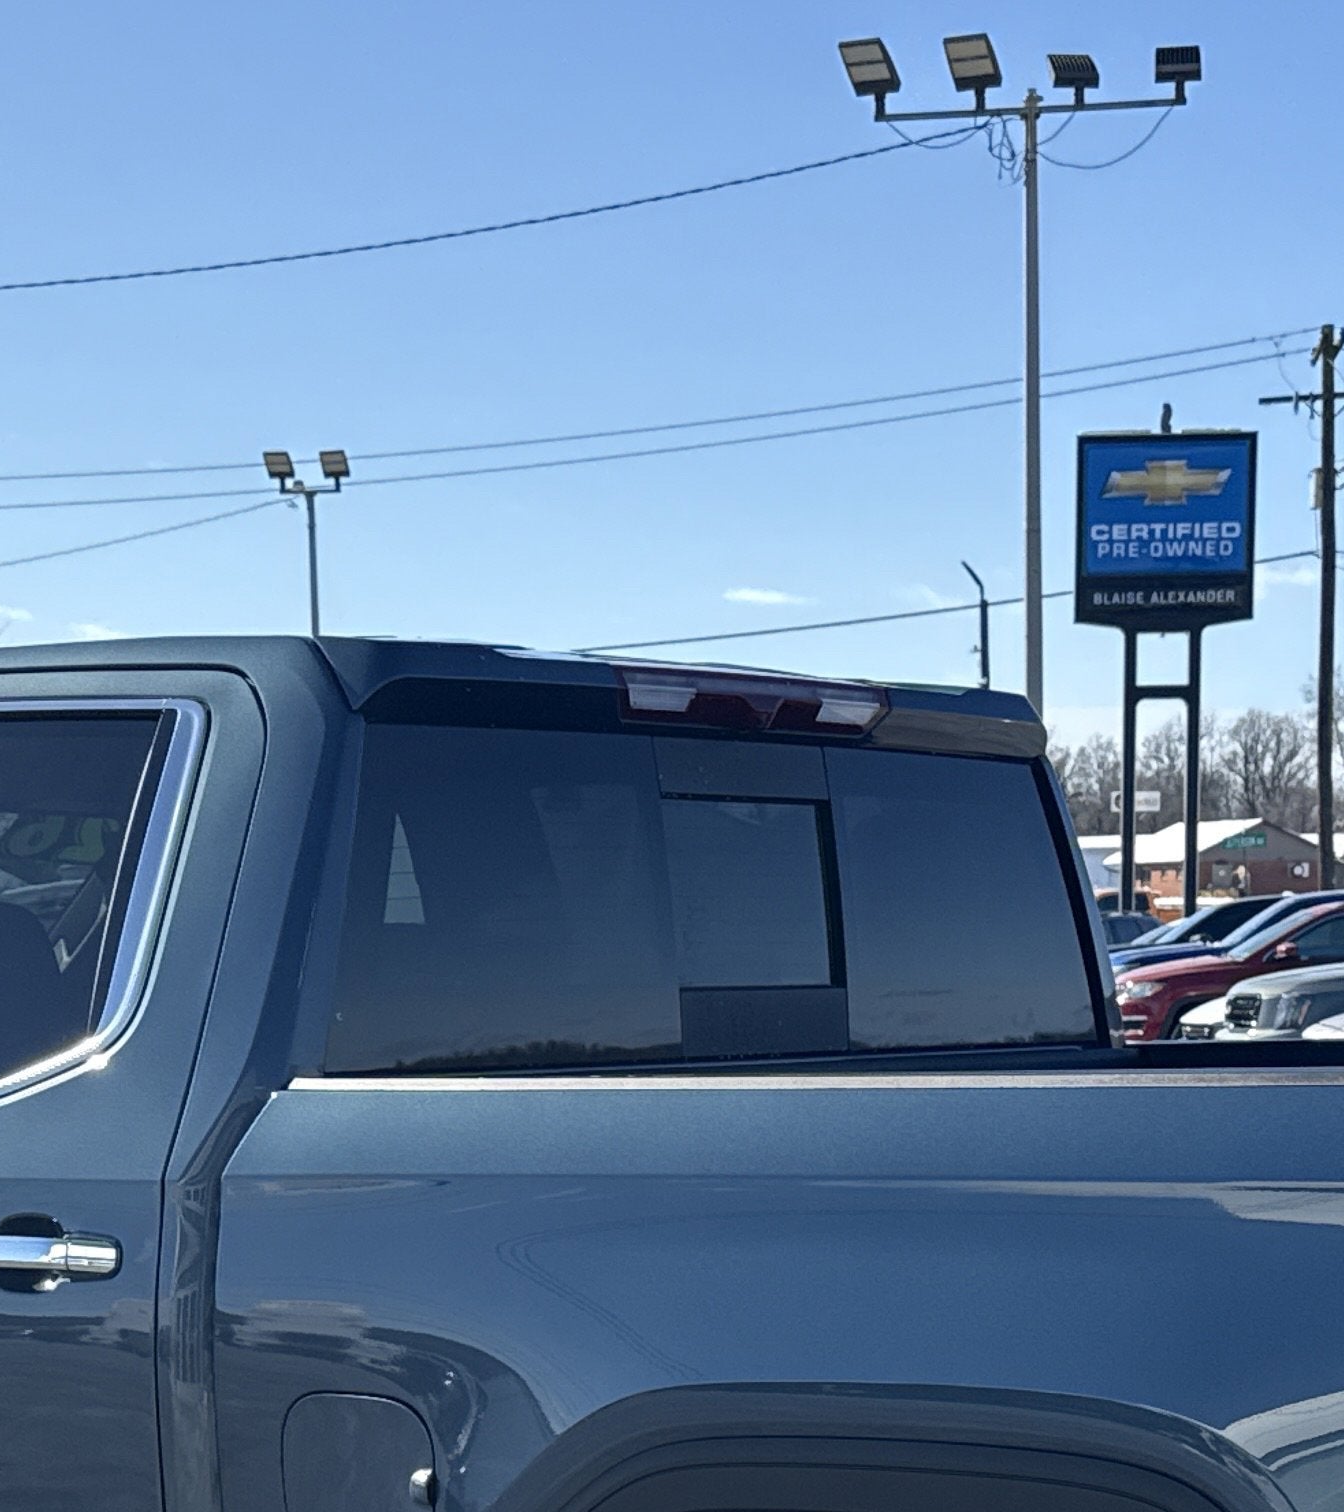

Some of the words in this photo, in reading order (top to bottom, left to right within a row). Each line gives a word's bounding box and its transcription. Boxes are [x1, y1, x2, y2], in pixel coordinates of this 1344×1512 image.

[1090, 522, 1242, 541] CERTIFIED
[1096, 540, 1234, 559] PRE-OWNED
[1093, 592, 1144, 605] BLAISE
[1150, 589, 1235, 604] ALEXANDER
